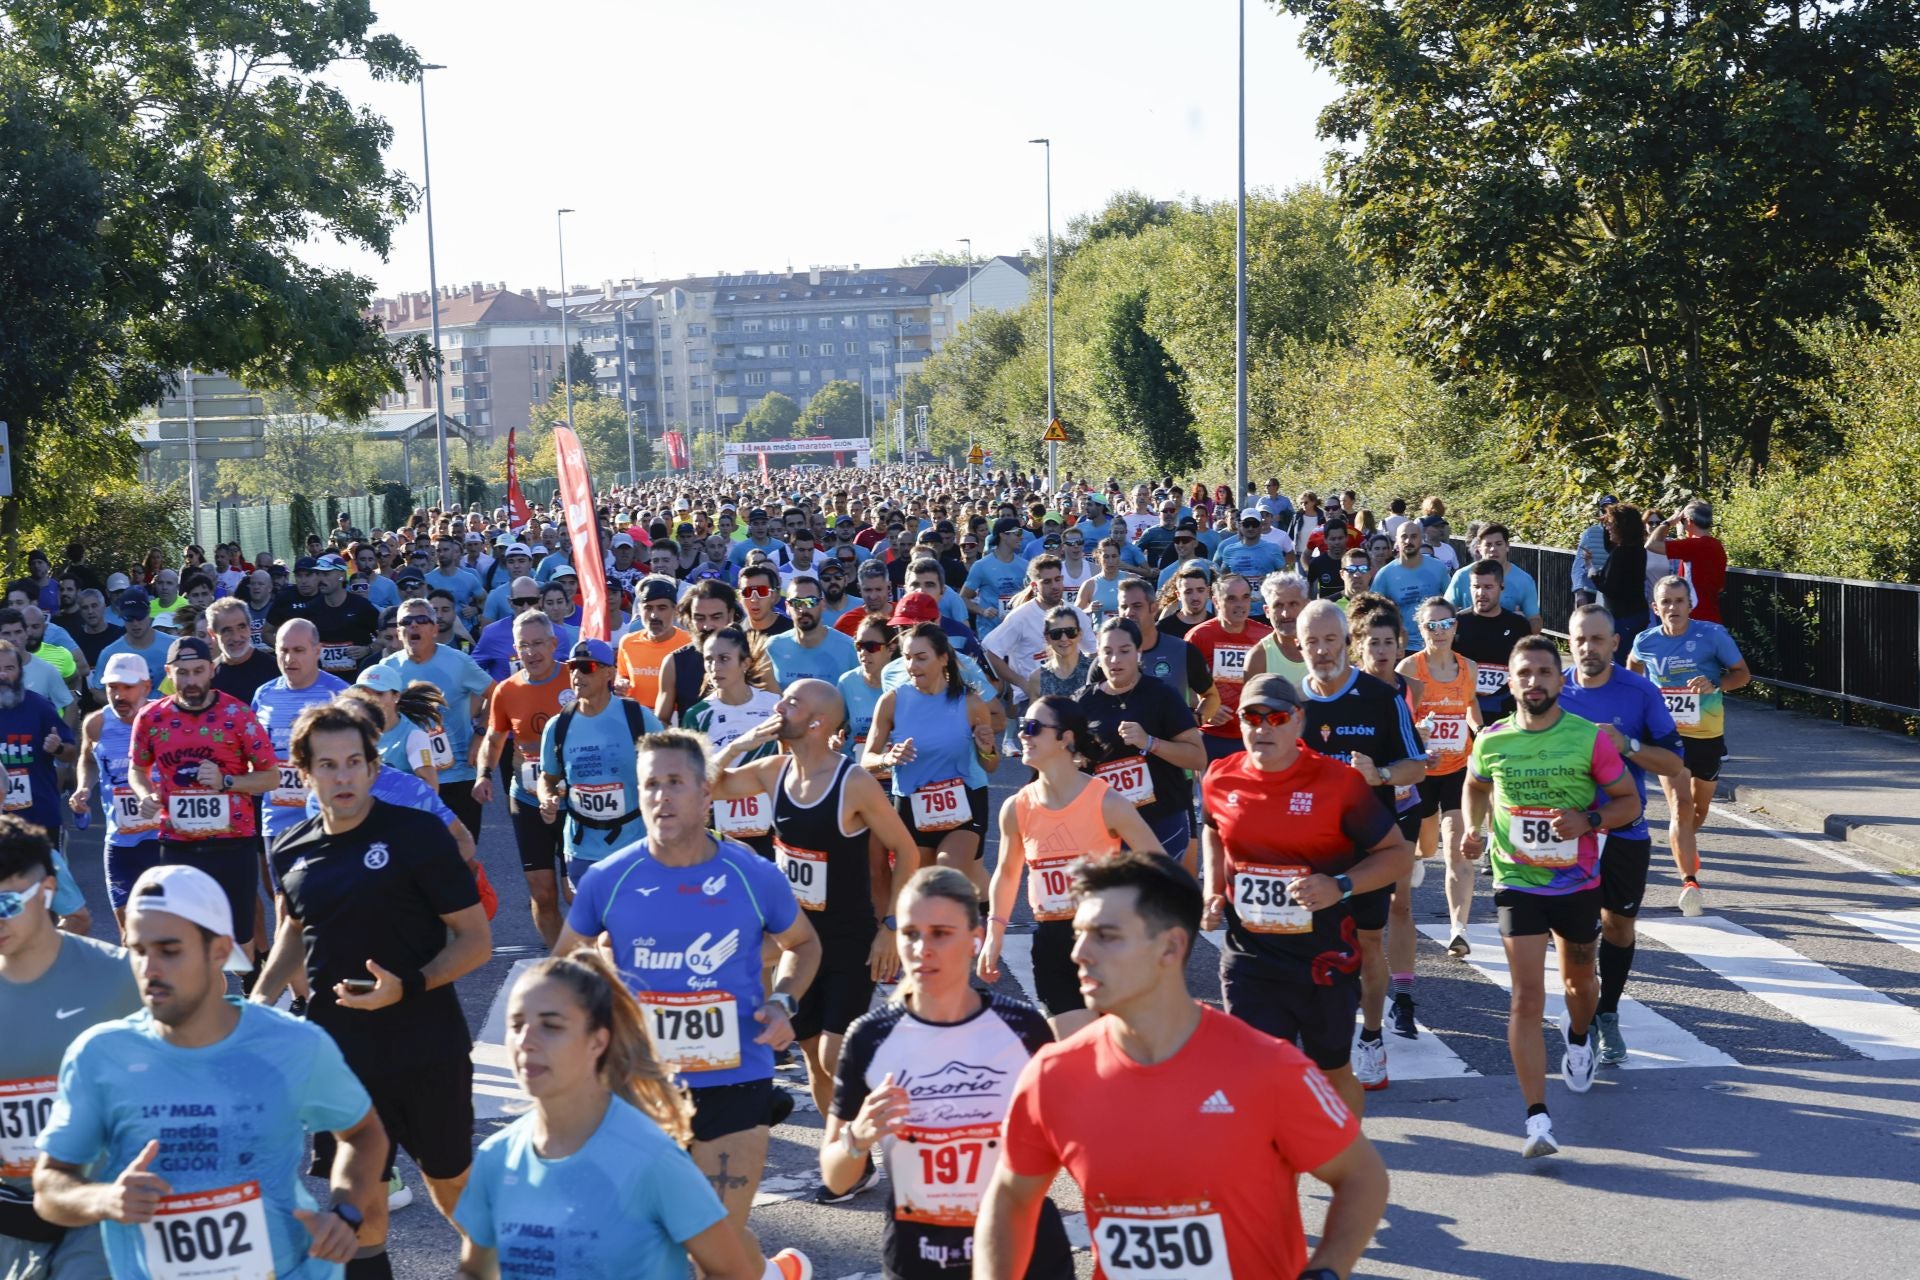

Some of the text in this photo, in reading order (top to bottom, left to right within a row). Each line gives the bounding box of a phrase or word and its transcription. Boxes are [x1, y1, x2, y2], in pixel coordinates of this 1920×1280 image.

[773, 443, 796, 451] media
[797, 442, 832, 450] maratón
[1336, 724, 1376, 736] GIJÓN
[1430, 721, 1460, 739] 262
[1505, 765, 1575, 777] En marcha
[1507, 780, 1548, 790] contra
[575, 792, 618, 812] 1504
[921, 790, 957, 814] 796
[1524, 791, 1568, 801] cáncer
[177, 797, 221, 818] 2168
[727, 796, 758, 817] 716
[632, 936, 657, 947] club
[634, 947, 712, 970] Run 04
[653, 1007, 724, 1040] 1780
[170, 1104, 216, 1117] MBA
[160, 1123, 218, 1139] media
[158, 1139, 218, 1153] aratón
[160, 1156, 218, 1172] GIJÓN
[918, 1143, 983, 1185] 197
[153, 1211, 253, 1263] 1602
[1105, 1222, 1213, 1270] 2350
